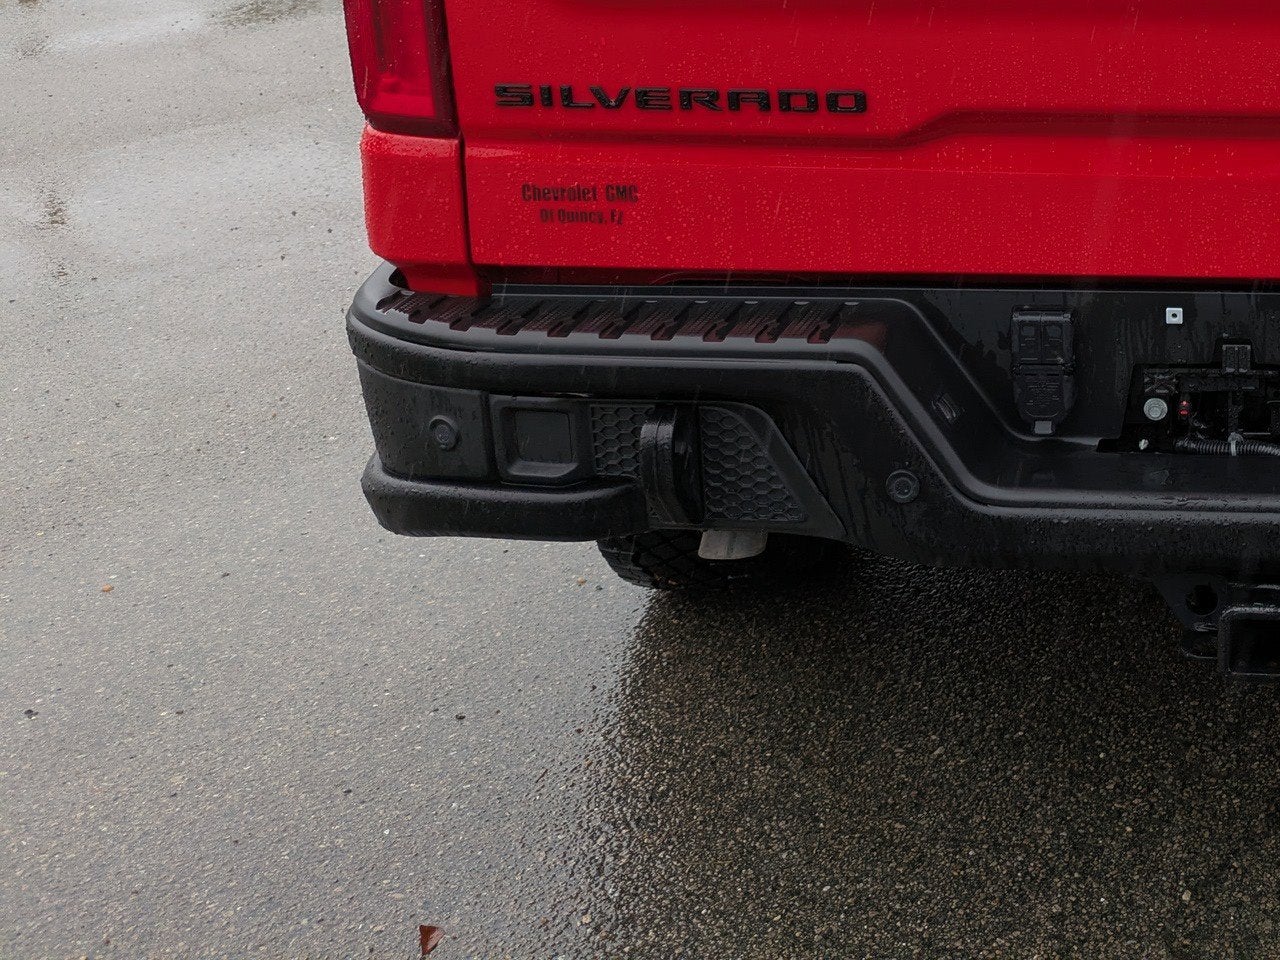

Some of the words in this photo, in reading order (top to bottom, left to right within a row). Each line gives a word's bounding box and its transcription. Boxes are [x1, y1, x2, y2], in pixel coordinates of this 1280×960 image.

[494, 84, 868, 113] SILVERADO
[521, 183, 598, 202] Chevrolet
[604, 184, 639, 202] GMC
